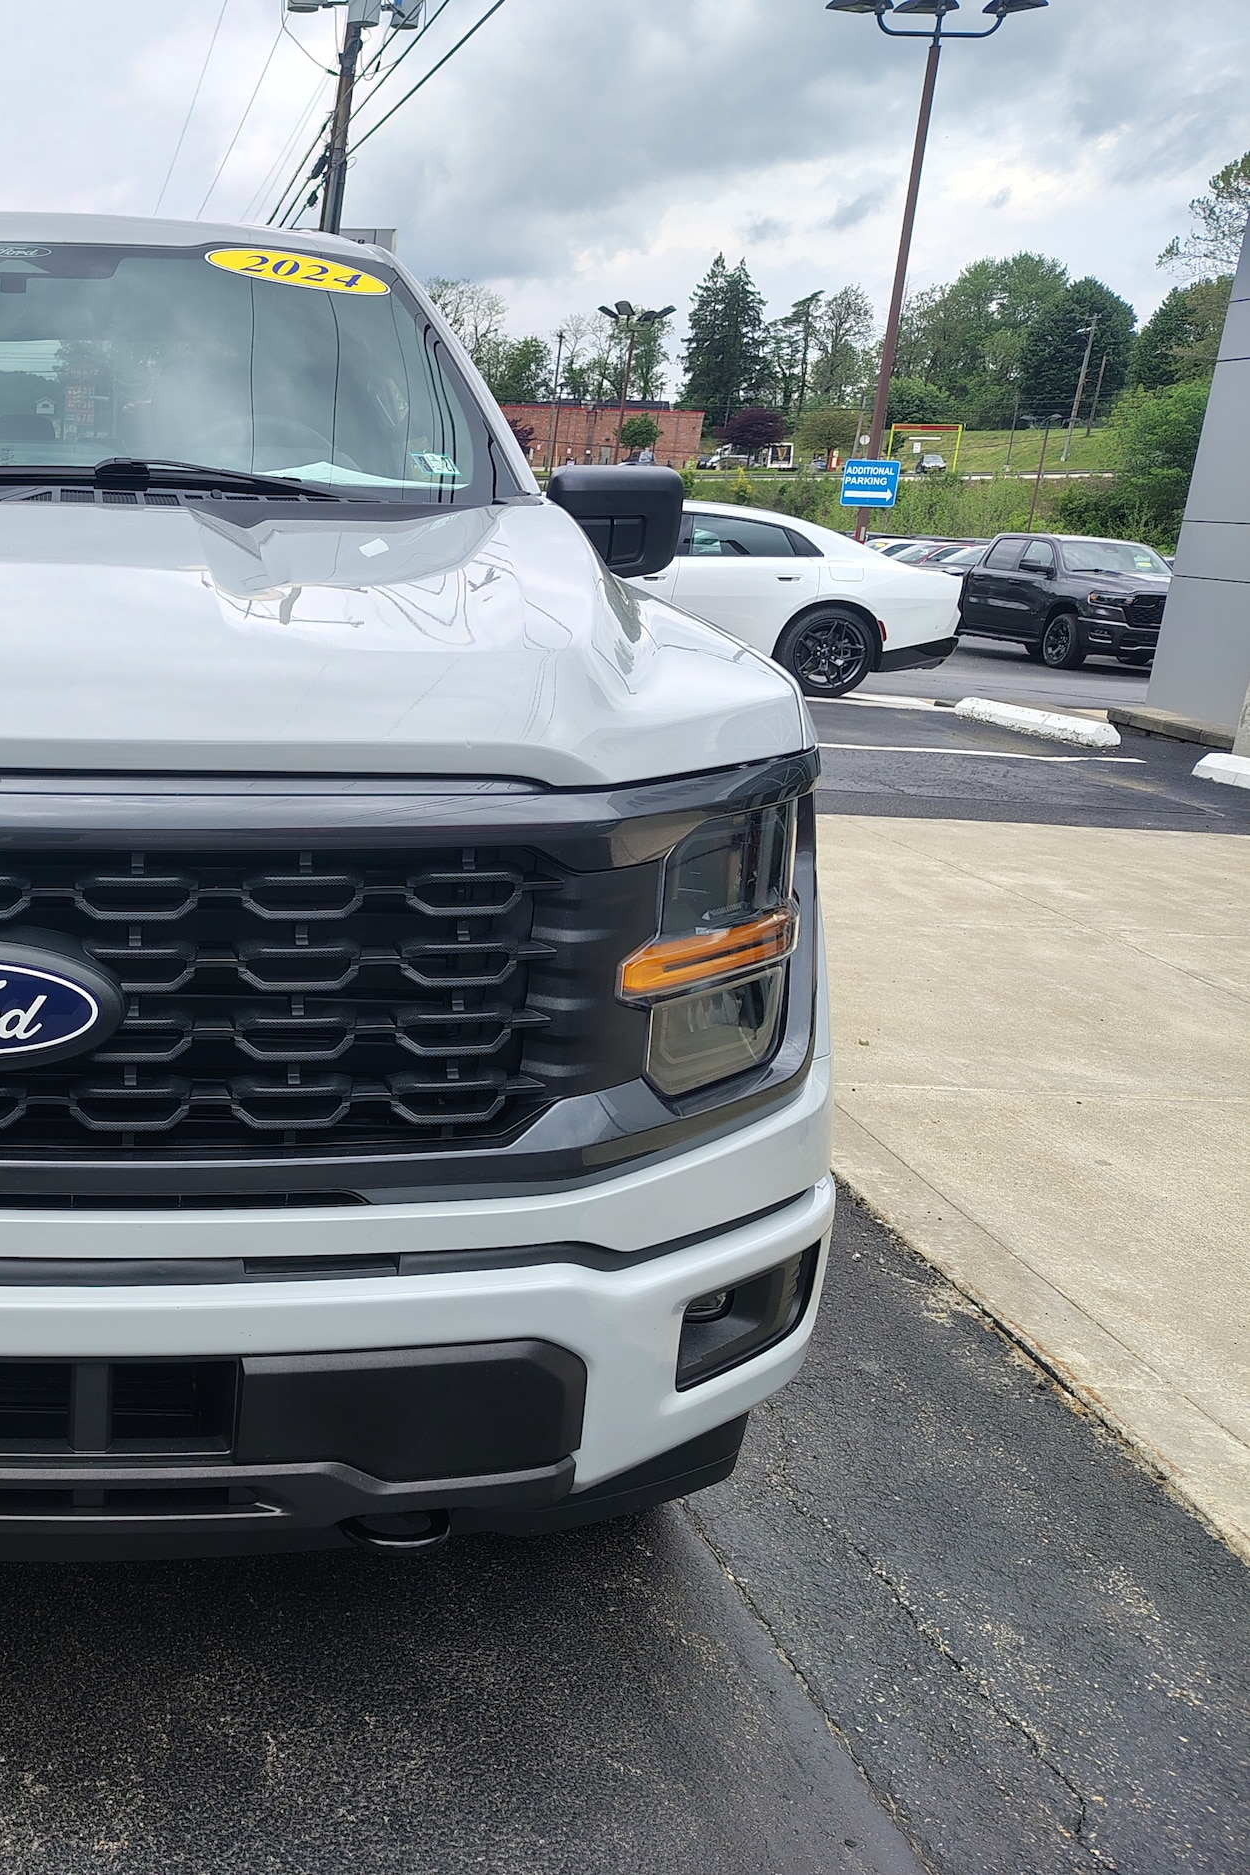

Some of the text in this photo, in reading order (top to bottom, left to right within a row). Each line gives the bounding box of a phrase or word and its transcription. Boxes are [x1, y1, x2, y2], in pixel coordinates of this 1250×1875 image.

[240, 255, 363, 288] 2024
[846, 466, 895, 475] ADDITIONAL
[845, 476, 888, 485] PARKING
